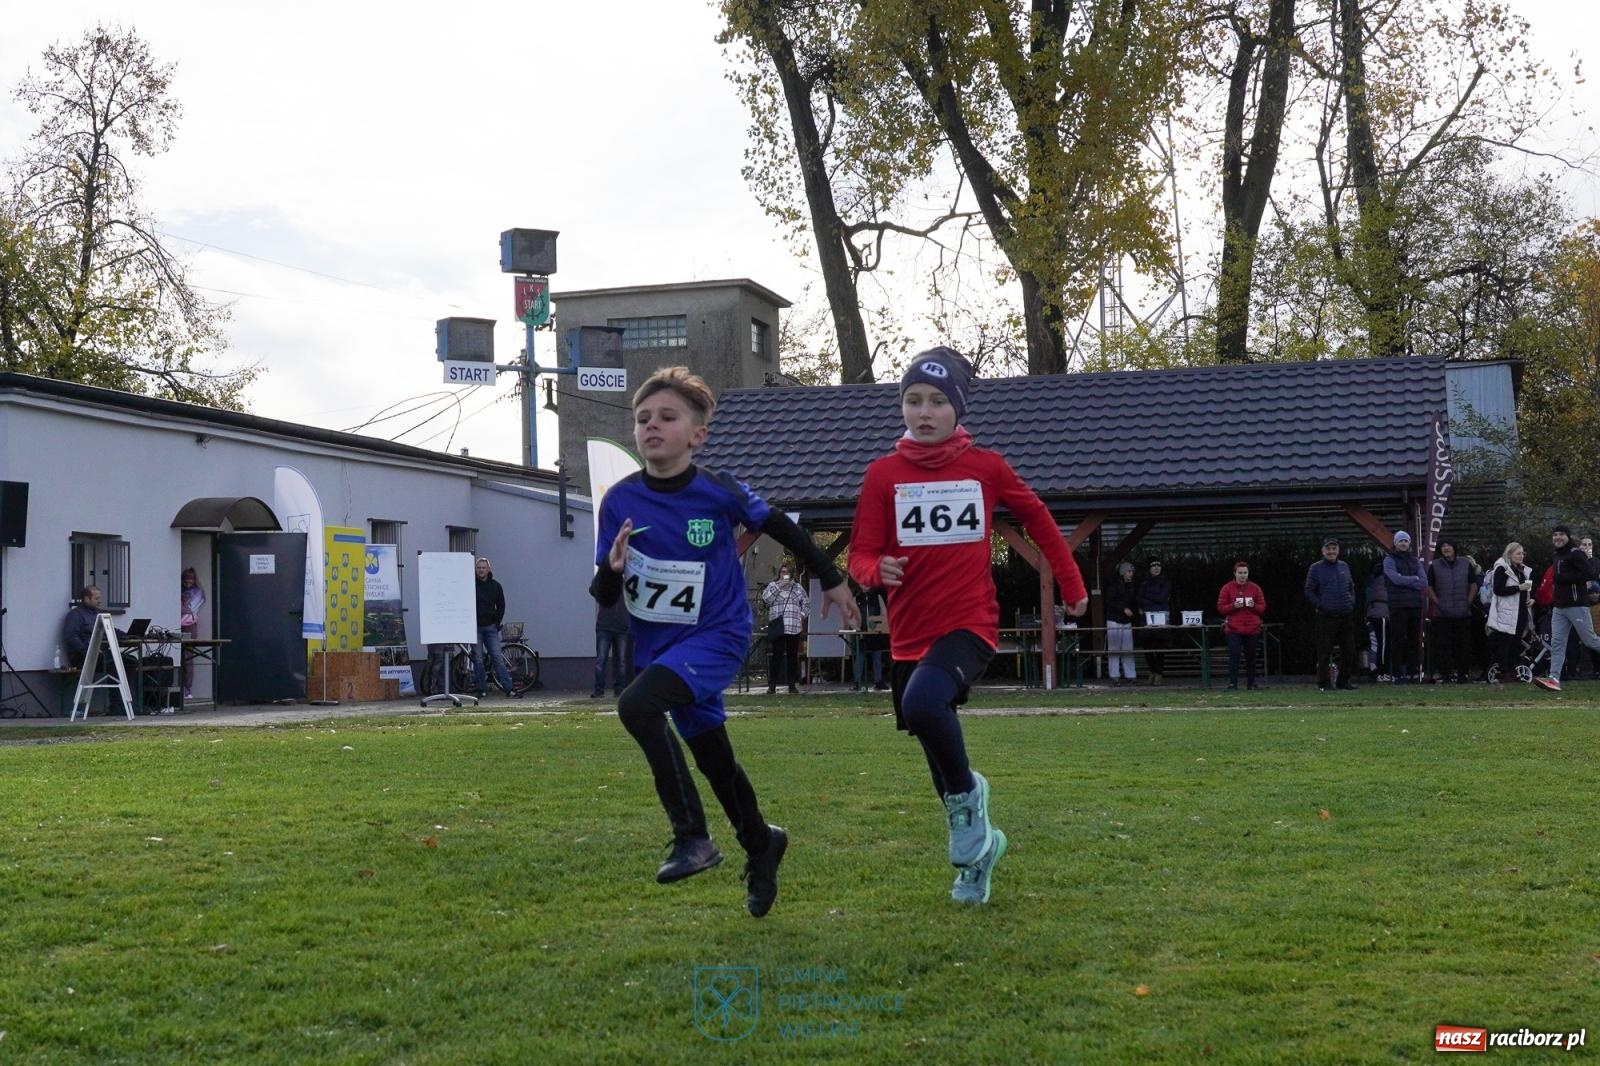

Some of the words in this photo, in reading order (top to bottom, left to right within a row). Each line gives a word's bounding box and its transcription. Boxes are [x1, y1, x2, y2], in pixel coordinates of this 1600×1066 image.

[524, 299, 542, 310] START
[449, 366, 491, 383] START
[580, 371, 625, 389] GOŚCIE
[901, 502, 980, 534] 464
[625, 573, 696, 613] 474
[347, 682, 353, 699] 2
